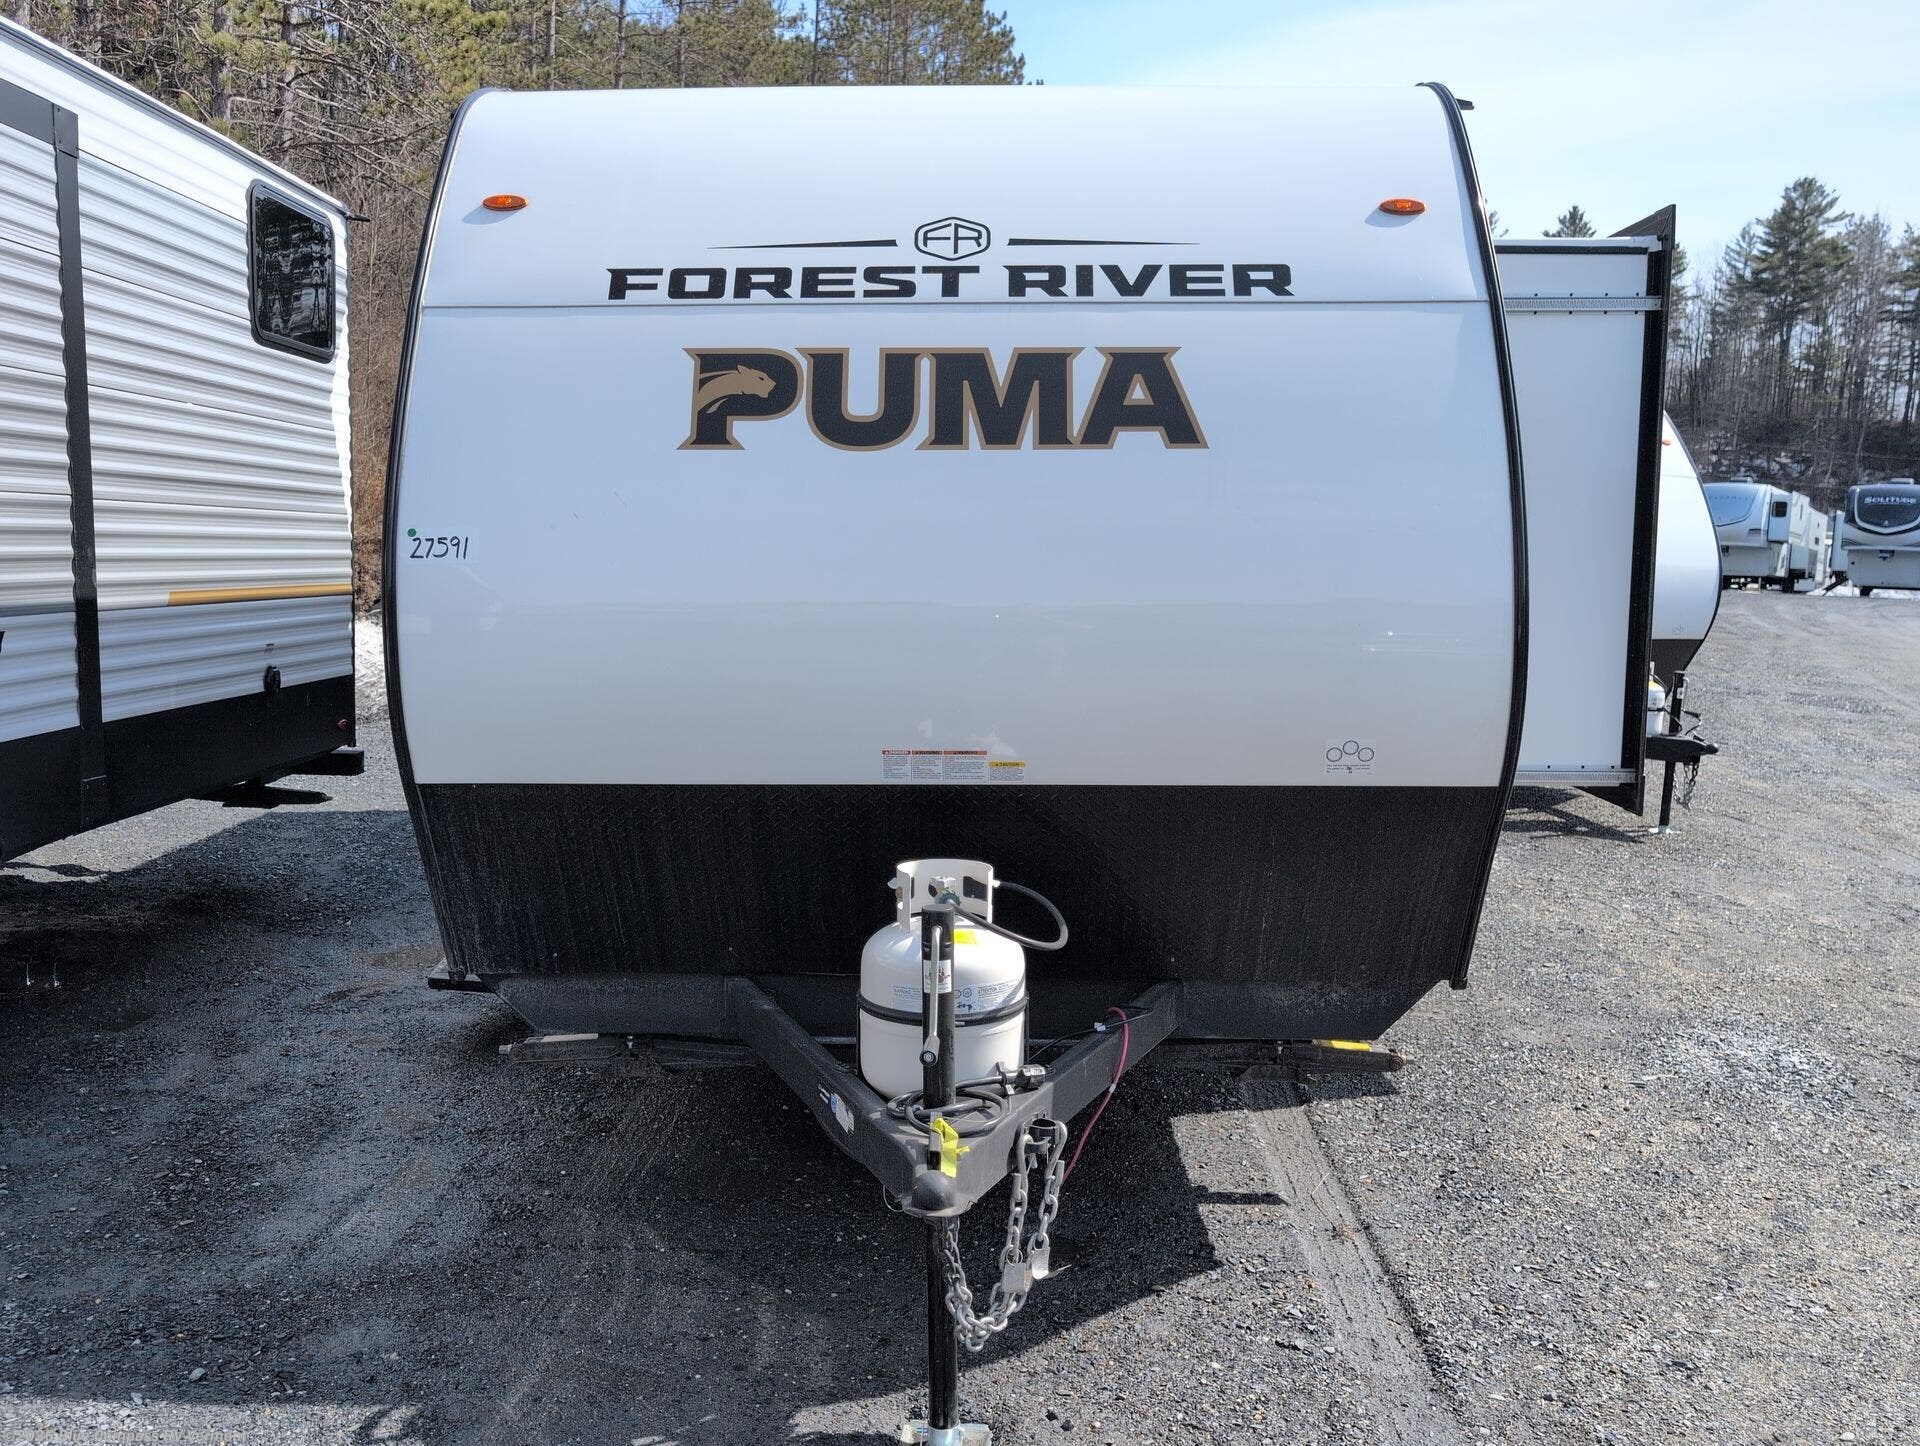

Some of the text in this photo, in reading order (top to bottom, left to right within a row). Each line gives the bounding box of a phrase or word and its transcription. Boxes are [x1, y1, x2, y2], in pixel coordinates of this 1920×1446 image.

[607, 264, 1295, 300] FOREST RIVER
[676, 346, 1210, 451] PUMA
[1864, 496, 1917, 504] SOLITUDE
[410, 536, 469, 560] 27591
